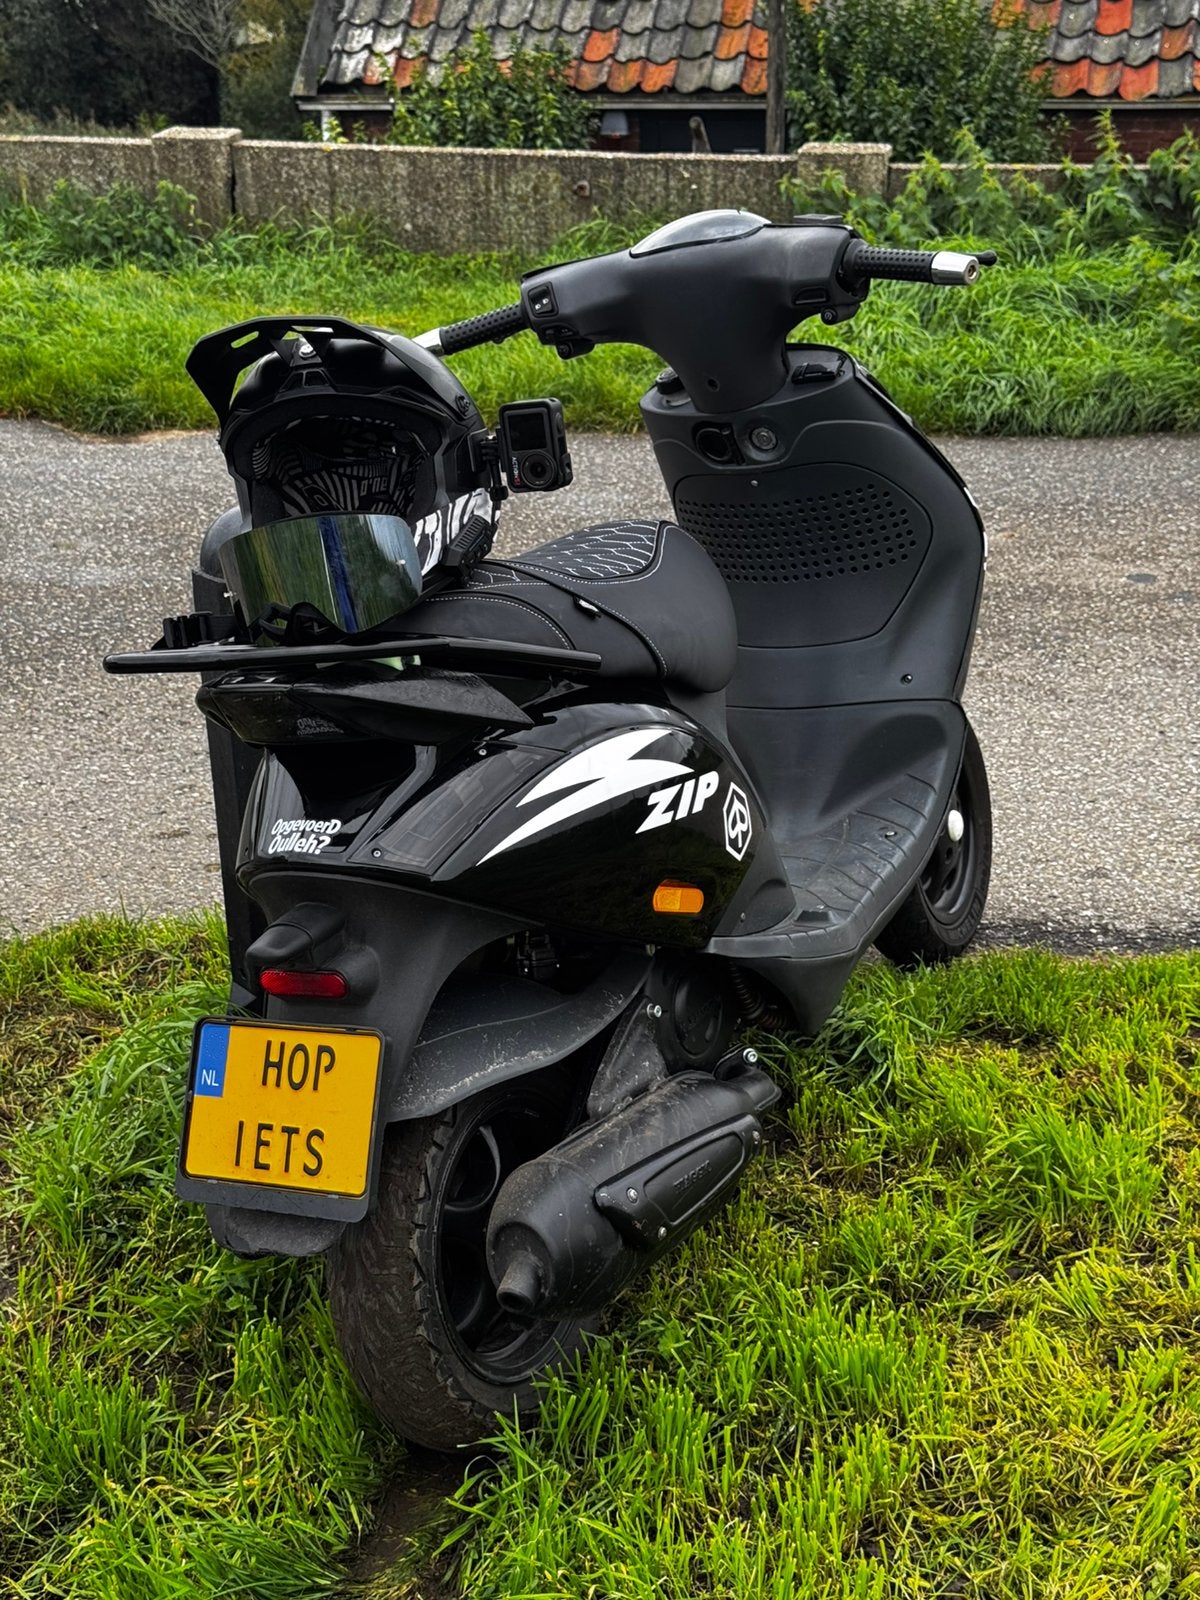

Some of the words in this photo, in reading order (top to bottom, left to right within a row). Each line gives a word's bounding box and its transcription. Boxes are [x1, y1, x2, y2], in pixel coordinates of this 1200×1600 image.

[635, 770, 720, 834] ZIP
[268, 832, 331, 855] Oulleh?
[271, 818, 342, 837] OpgevoerD
[201, 1069, 220, 1087] NL
[261, 1039, 336, 1091] HOP
[234, 1120, 326, 1177] IETS
